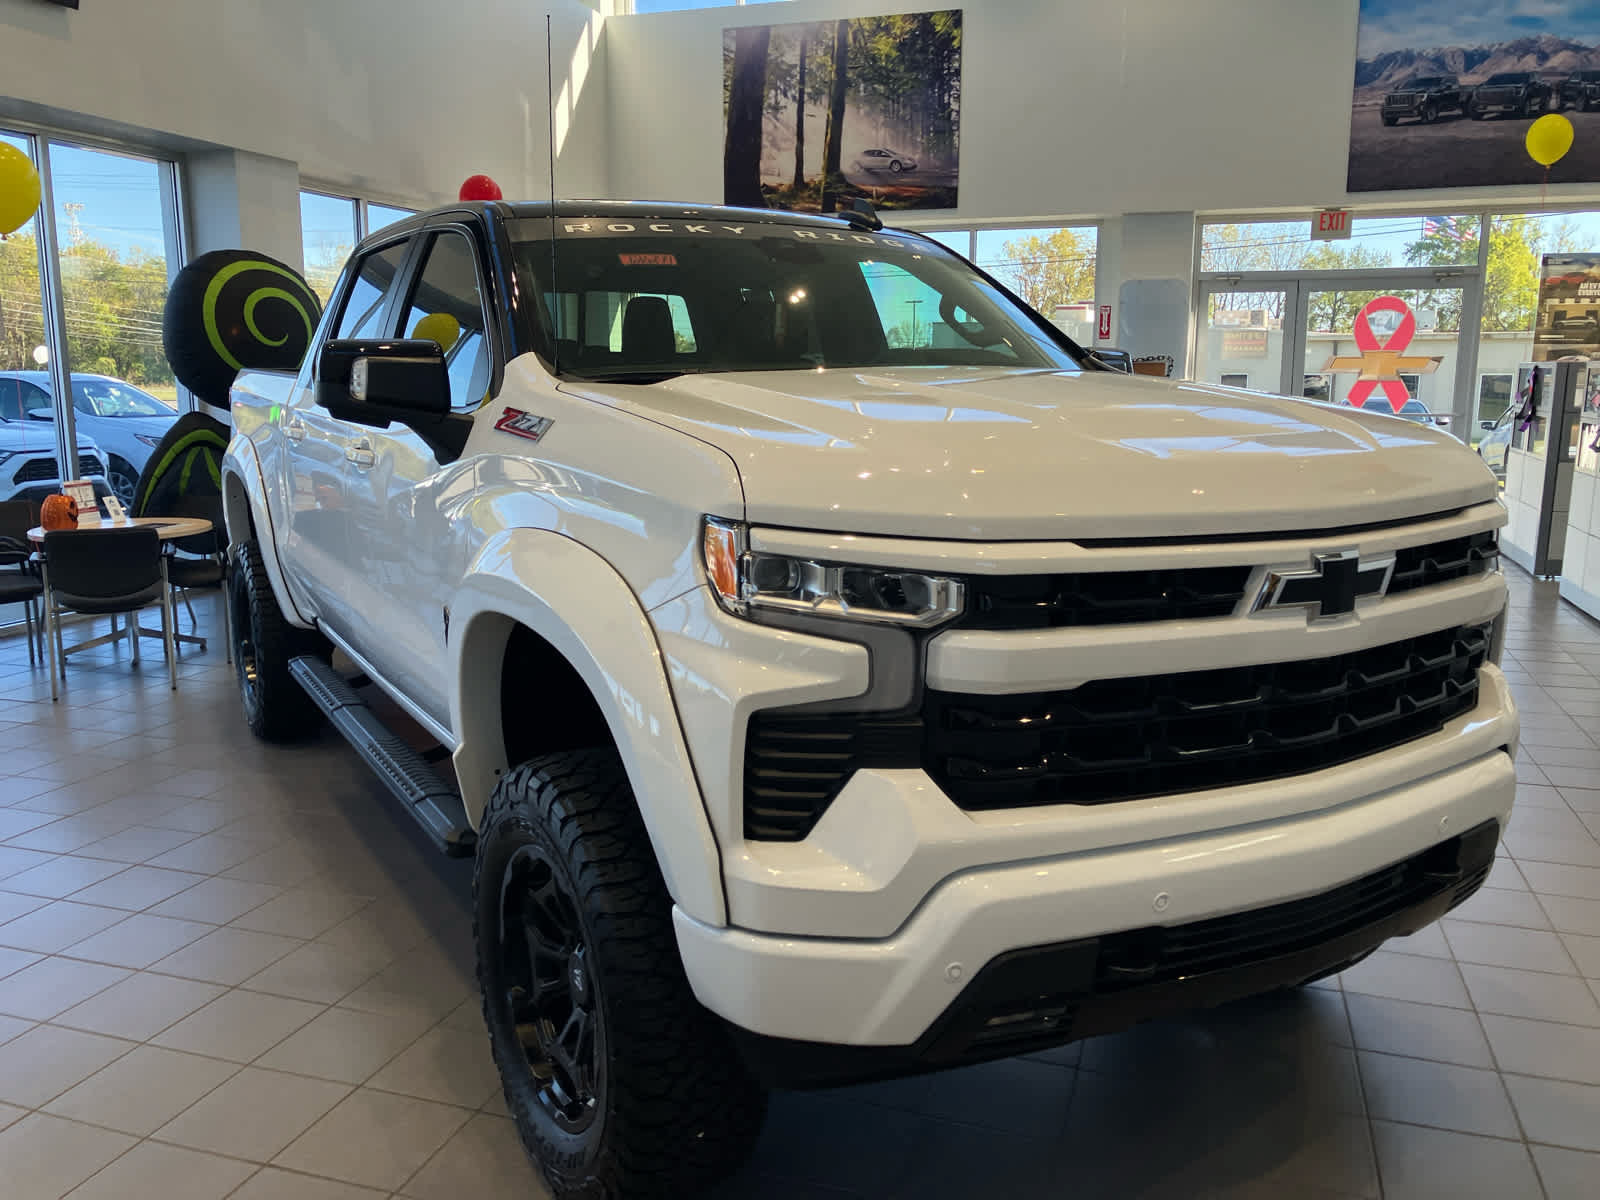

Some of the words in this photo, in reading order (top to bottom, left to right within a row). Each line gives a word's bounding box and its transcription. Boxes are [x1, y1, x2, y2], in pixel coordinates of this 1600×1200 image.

[563, 223, 745, 235] ROCKY
[1319, 211, 1348, 232] EXIT
[494, 406, 556, 444] Z71
